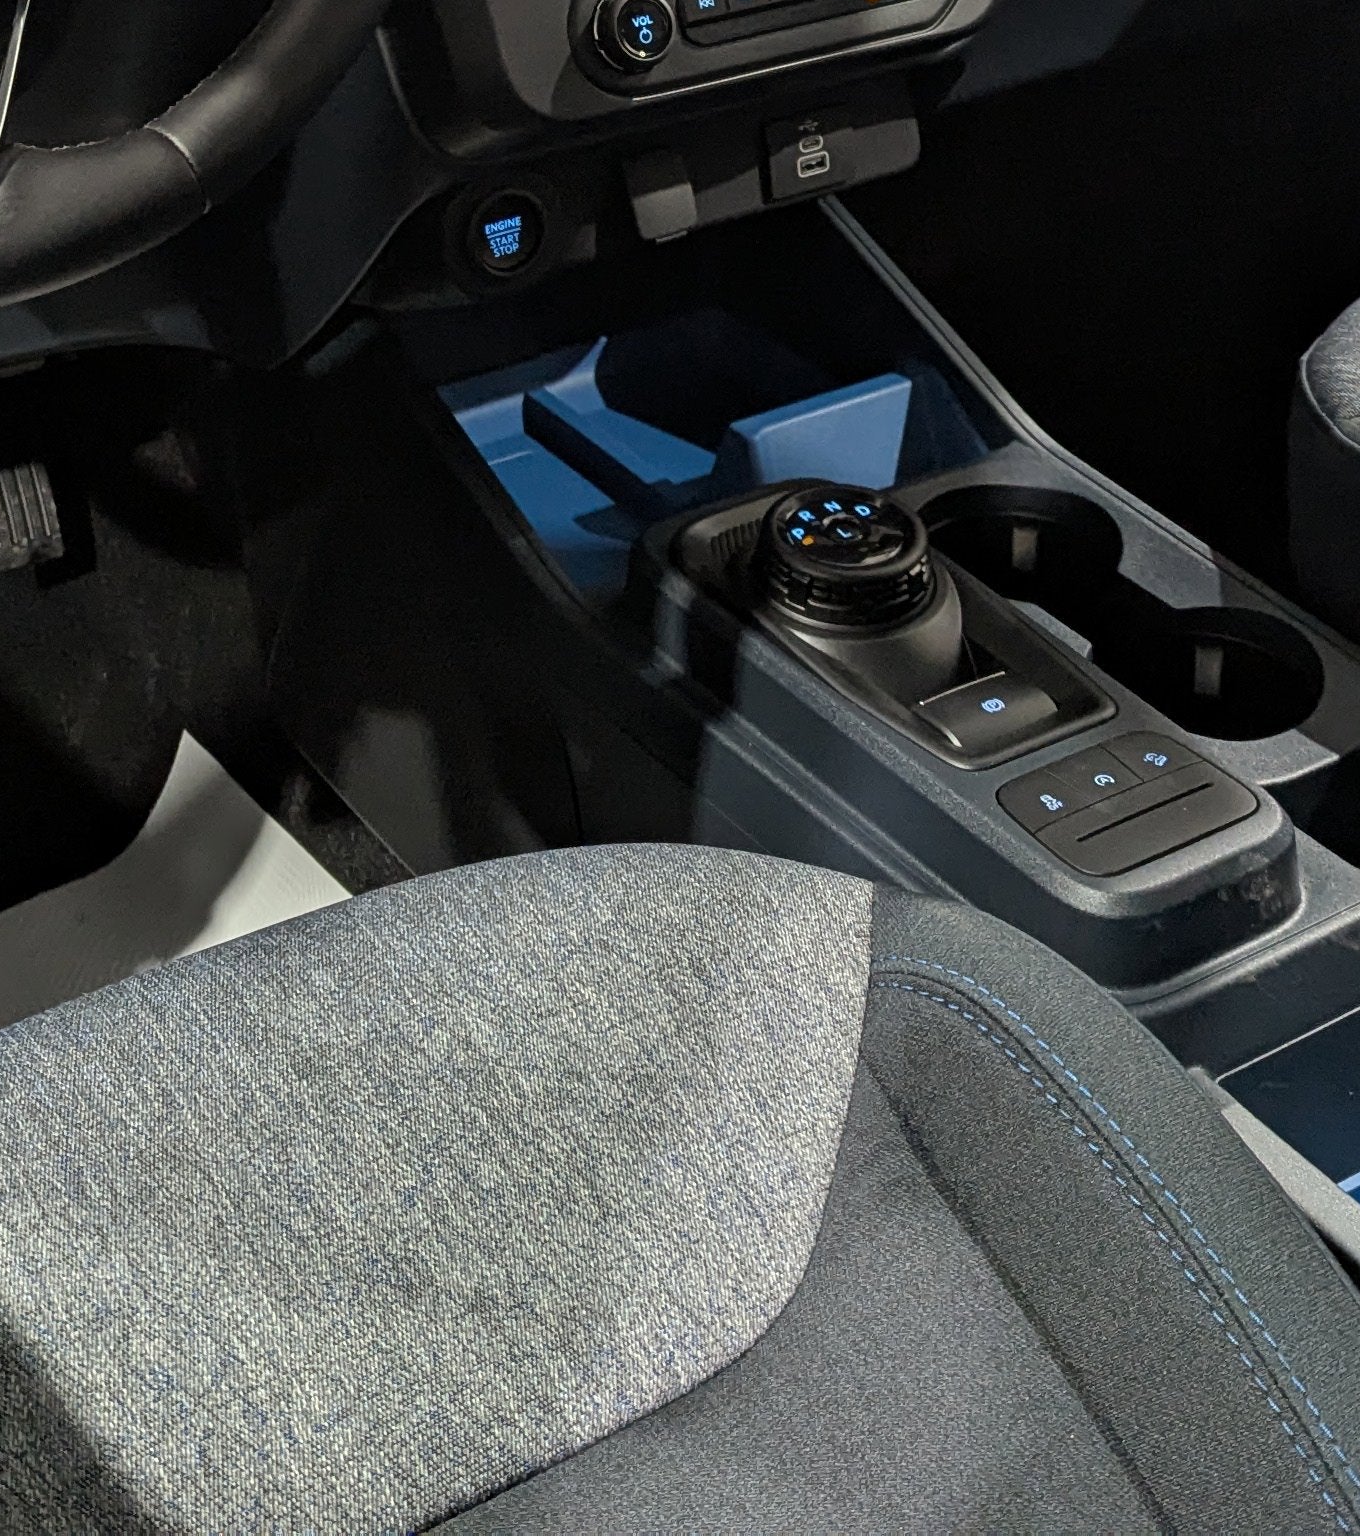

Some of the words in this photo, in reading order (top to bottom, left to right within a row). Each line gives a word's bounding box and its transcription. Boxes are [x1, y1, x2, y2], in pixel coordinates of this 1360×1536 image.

[631, 14, 654, 28] VOL
[484, 216, 522, 235] ENGINE
[490, 232, 520, 249] START
[493, 242, 519, 258] STOP
[823, 500, 843, 513] N
[854, 505, 871, 517] D
[797, 510, 816, 522] R
[791, 527, 805, 540] P
